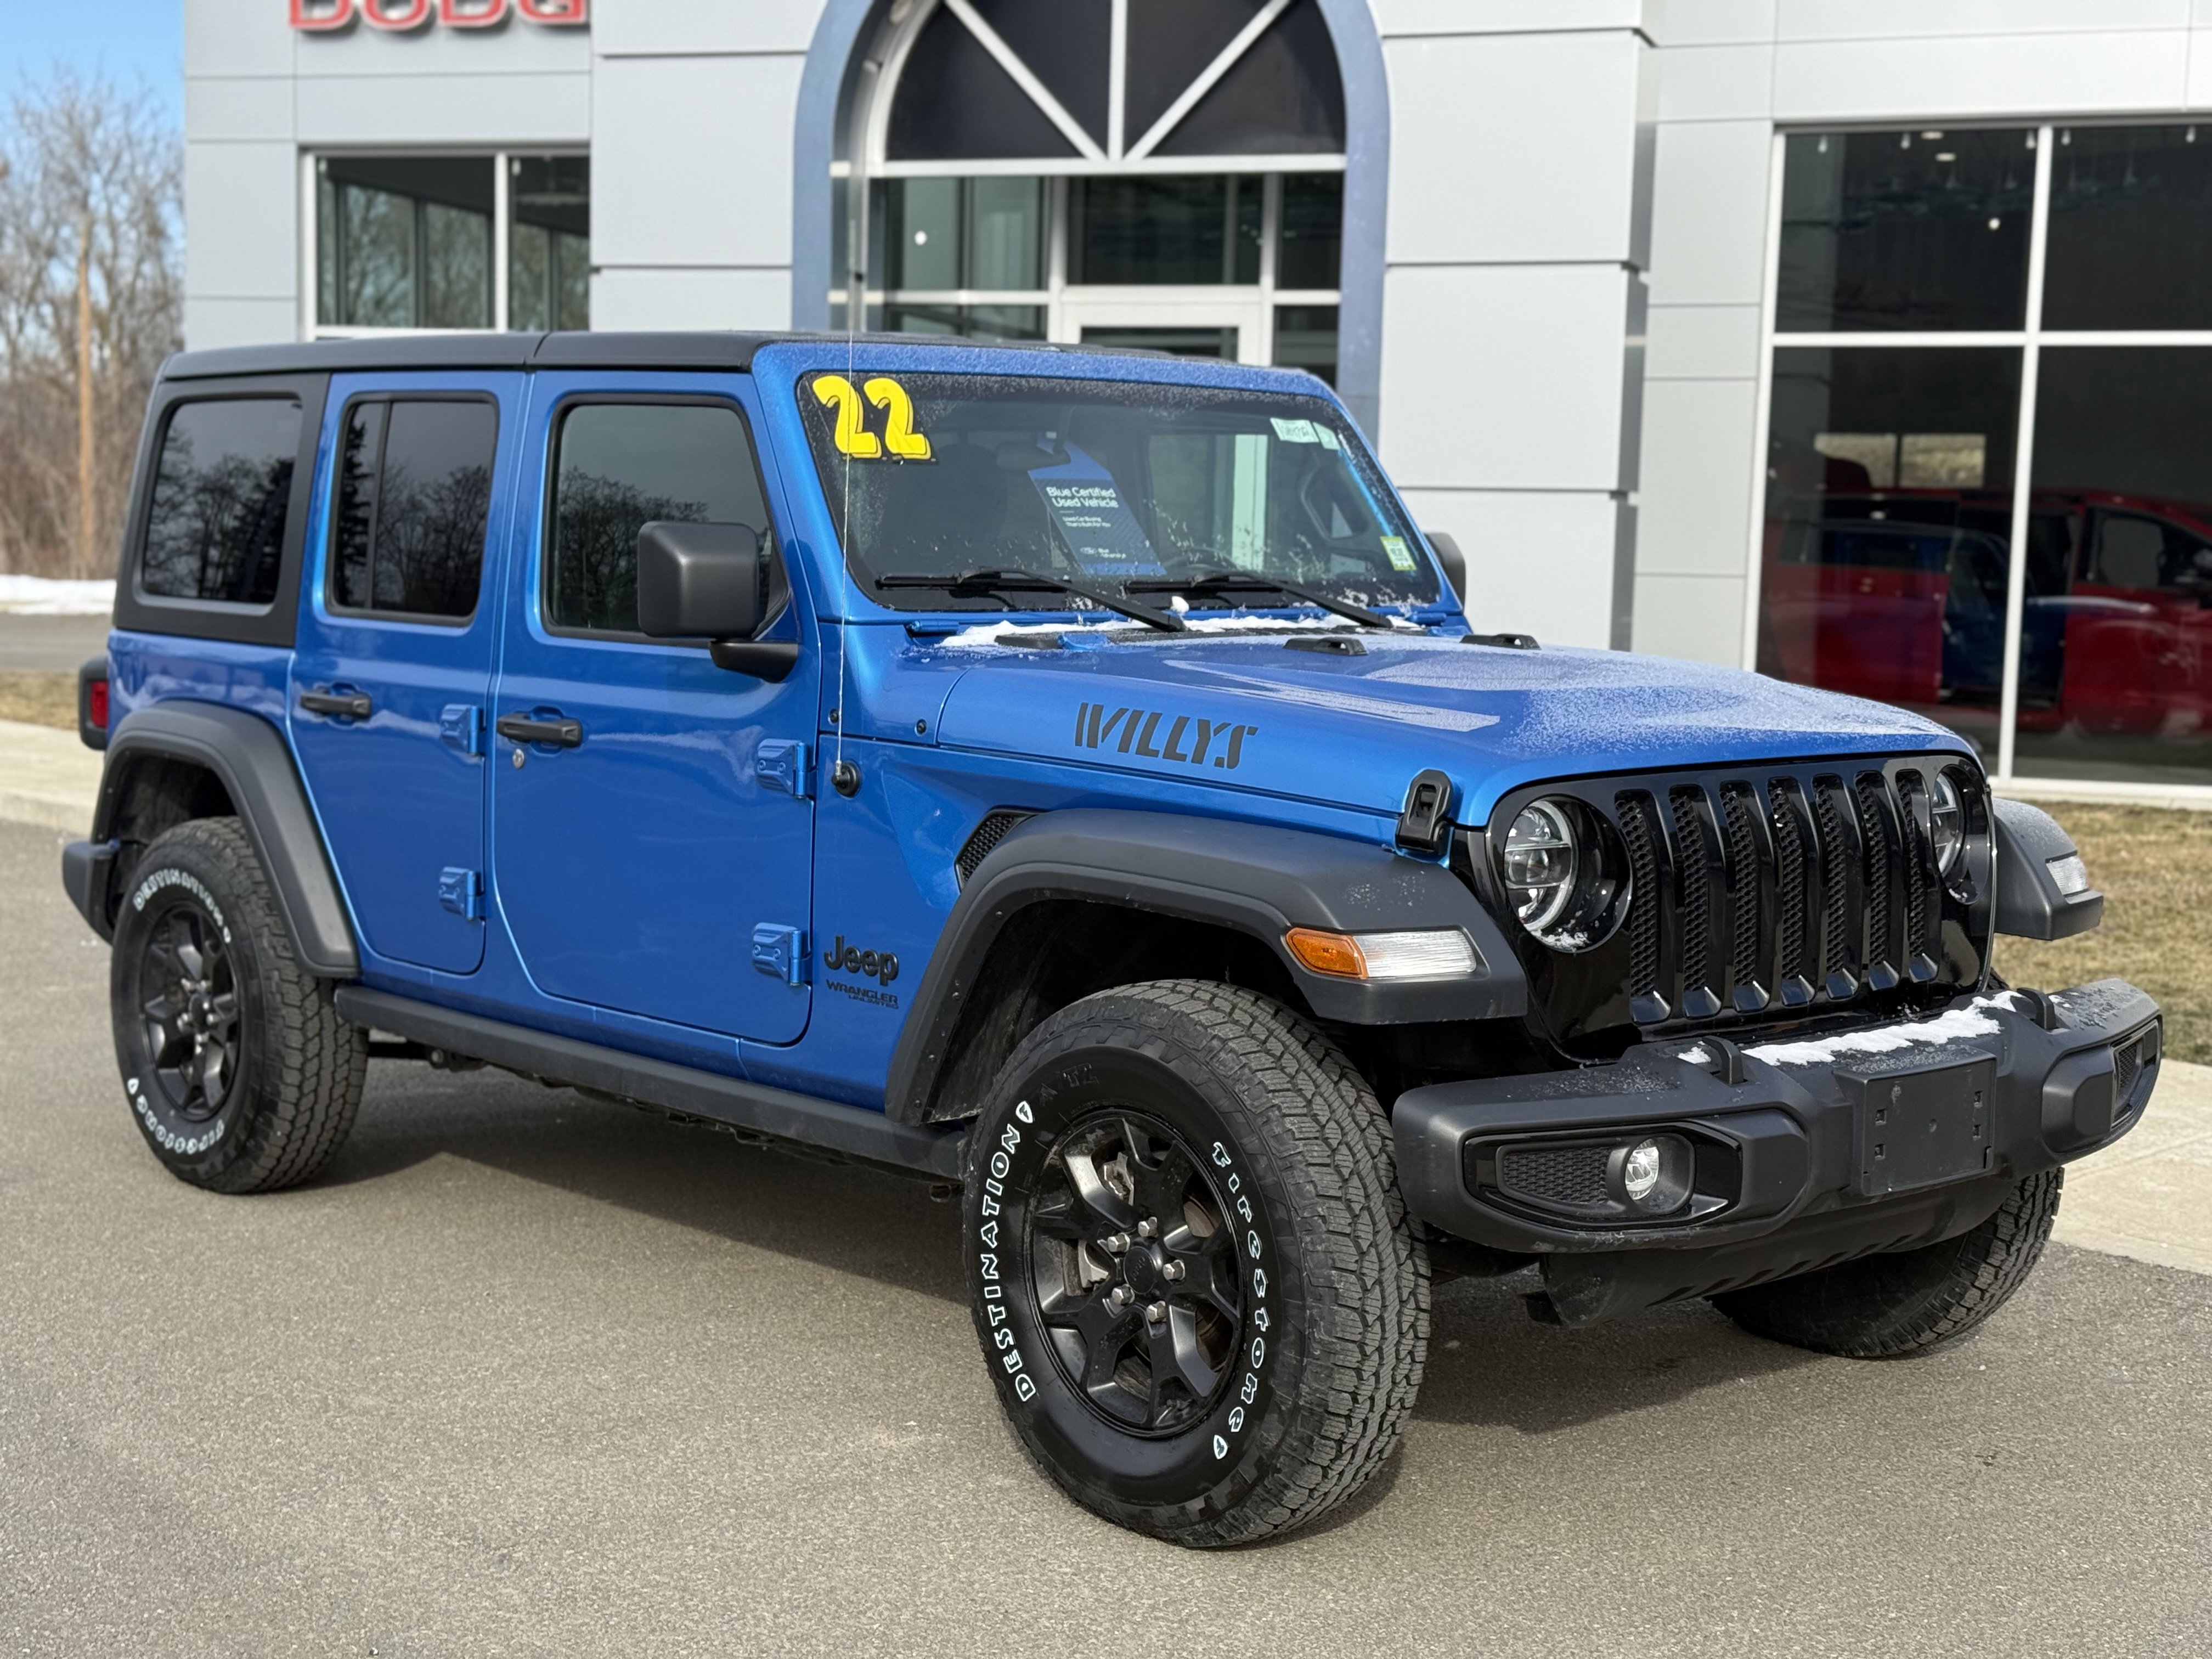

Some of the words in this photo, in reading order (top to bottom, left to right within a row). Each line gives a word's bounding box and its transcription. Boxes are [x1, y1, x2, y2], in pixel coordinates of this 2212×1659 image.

[812, 375, 932, 459] 22
[1046, 486, 1072, 496] Blue
[1071, 487, 1116, 498] Certified
[1052, 497, 1081, 507] Used
[1080, 497, 1119, 508] Vehicle
[1074, 702, 1259, 770] WILLYS
[824, 935, 900, 987] Jeep
[826, 979, 898, 1005] WRANGLER
[848, 994, 900, 1009] UNLIMITED
[980, 1123, 1036, 1402] DESTINATION
[1212, 1141, 1271, 1432] Firestone
